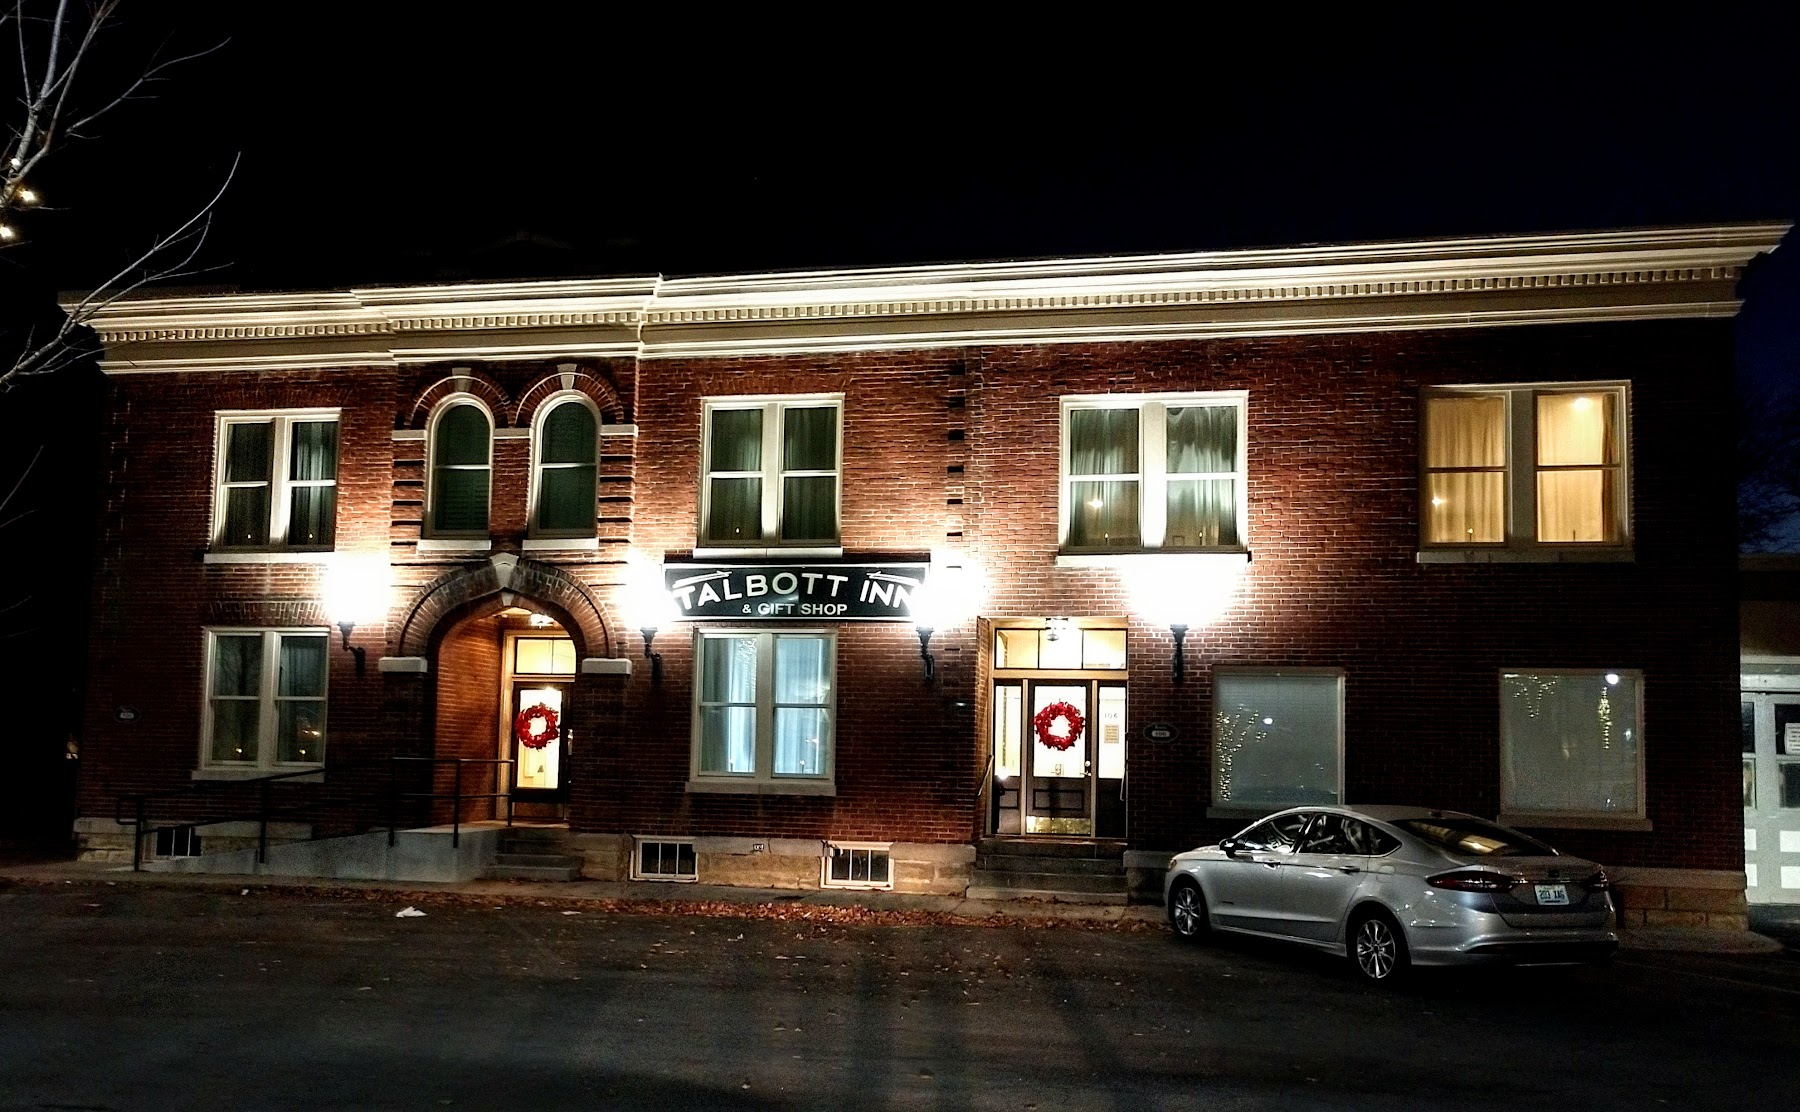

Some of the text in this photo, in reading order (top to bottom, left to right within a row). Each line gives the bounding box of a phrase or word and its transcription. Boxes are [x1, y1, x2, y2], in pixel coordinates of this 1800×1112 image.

[673, 571, 849, 610] TALBOTT
[742, 602, 848, 616] & GIFT SHOP
